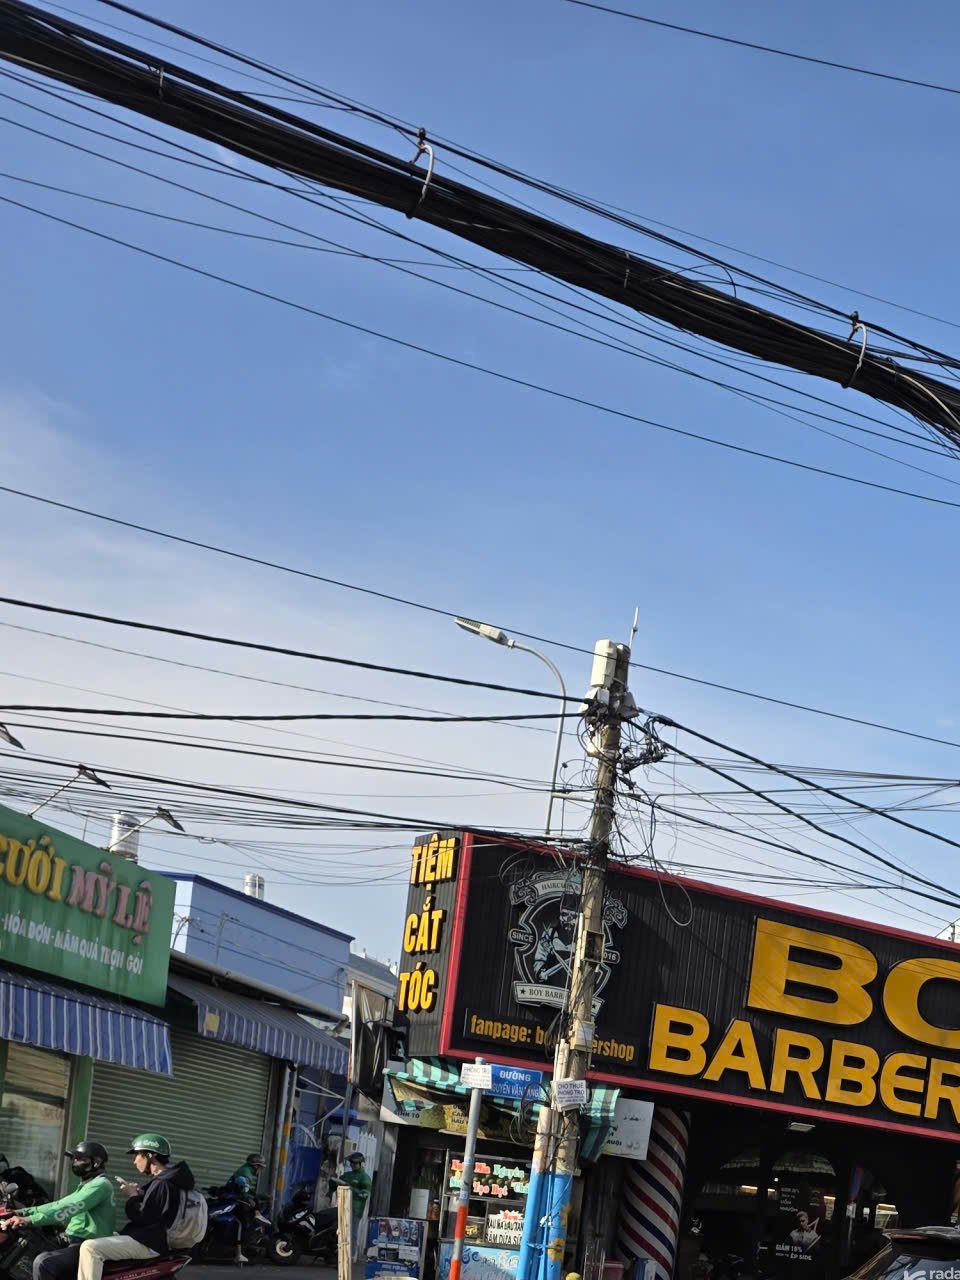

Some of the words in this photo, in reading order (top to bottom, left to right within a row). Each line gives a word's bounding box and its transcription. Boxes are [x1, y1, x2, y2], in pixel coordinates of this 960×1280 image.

[410, 833, 456, 891] TIỆM
[404, 896, 443, 953] CẮT
[511, 931, 535, 944] SINCE
[399, 962, 435, 1011] TÓC
[470, 1013, 533, 1045] fanpage:
[491, 1081, 512, 1096] GUYỄN
[499, 1070, 533, 1083] ĐƯỜNG
[53, 1200, 86, 1223] Grab
